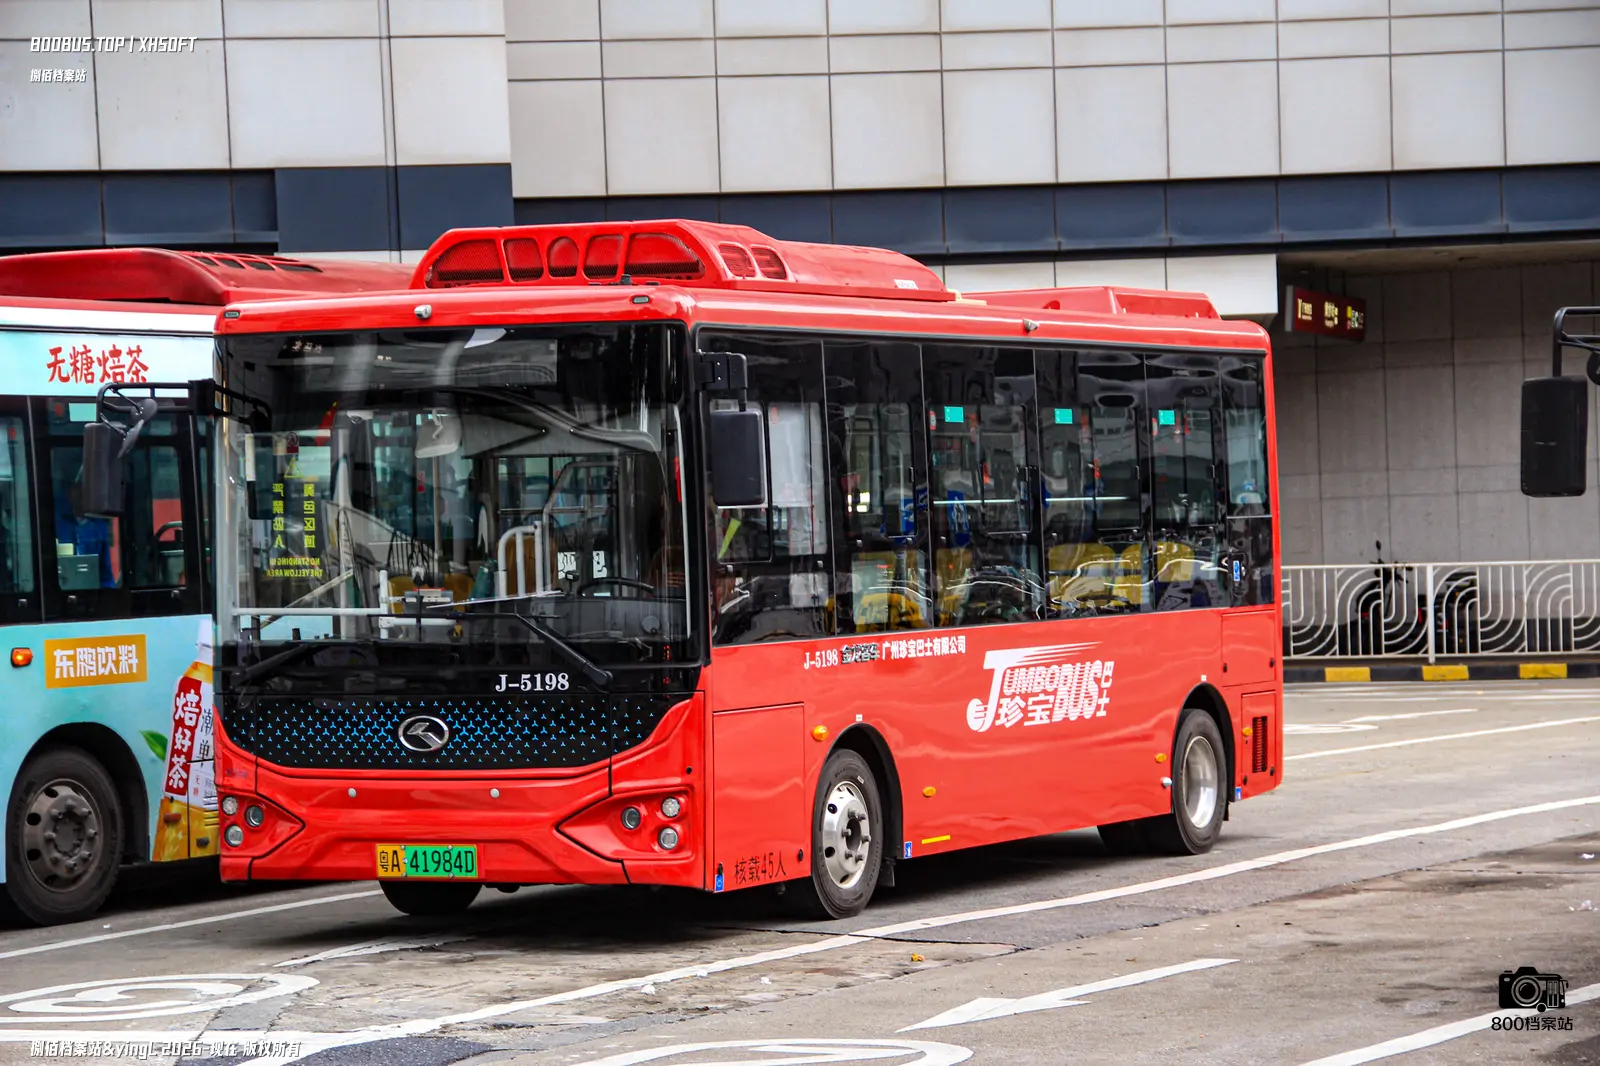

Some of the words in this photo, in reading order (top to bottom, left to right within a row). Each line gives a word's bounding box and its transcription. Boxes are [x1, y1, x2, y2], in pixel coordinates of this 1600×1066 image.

[46, 343, 149, 384] 无糖焙茶
[53, 644, 138, 679] 东鹏饮料
[803, 650, 838, 670] J-5198
[881, 635, 966, 660] 广州珍宝巴士有限公司
[495, 672, 570, 692] J-5198
[1096, 660, 1115, 717] 巴士
[994, 694, 1055, 729] 珍宝
[168, 688, 200, 789] 焙好茶
[409, 850, 475, 873] 41984D
[734, 852, 787, 884] 核载45人
